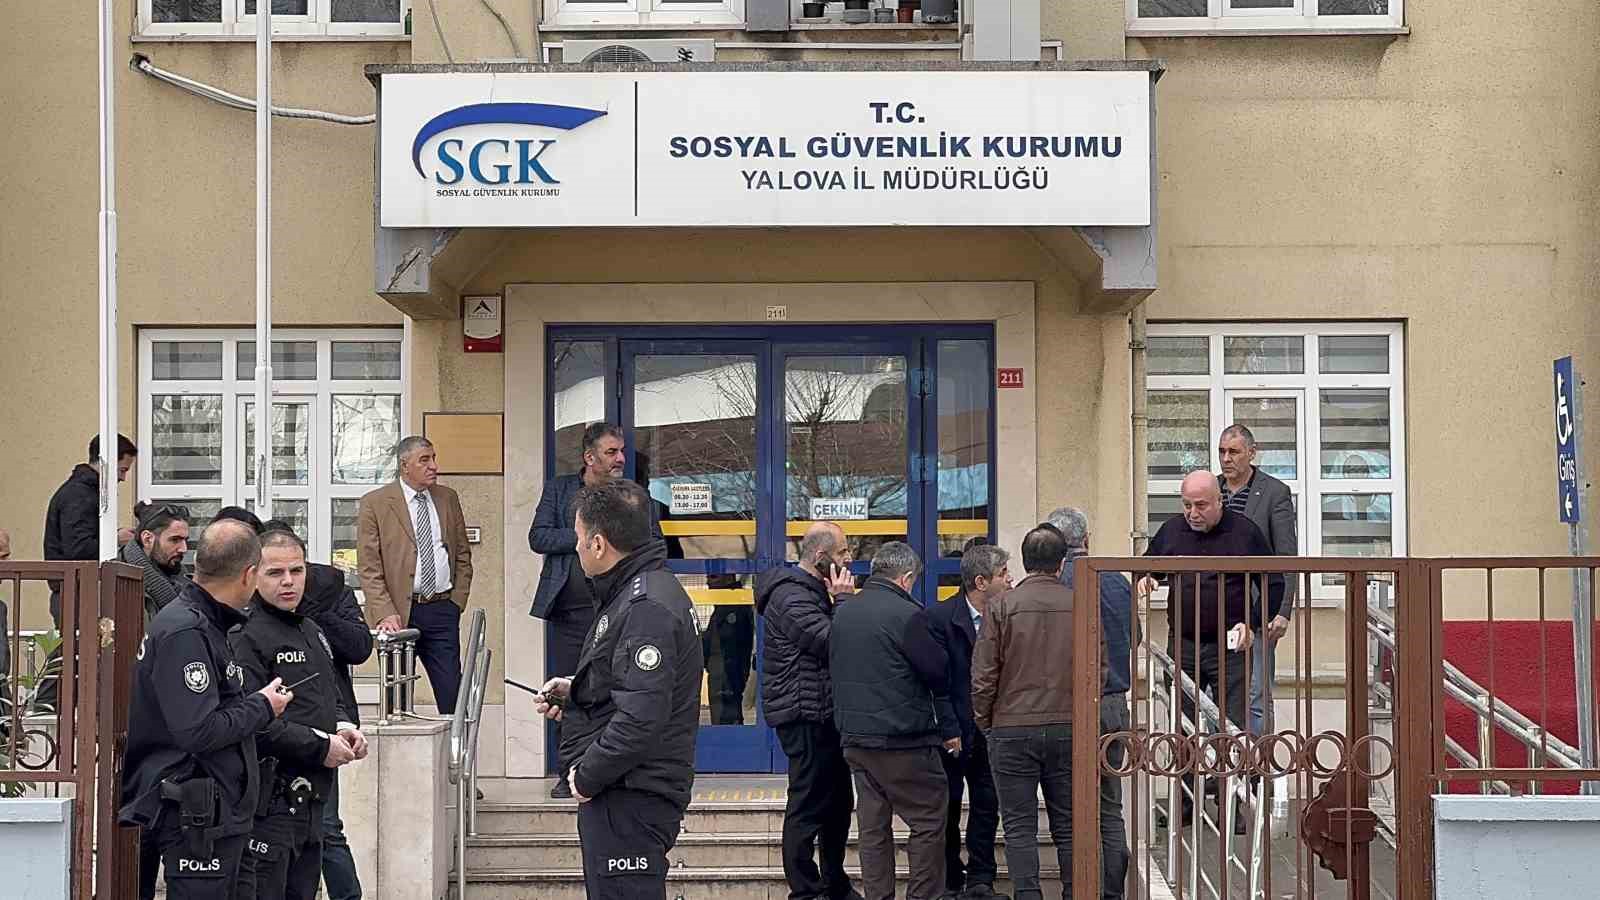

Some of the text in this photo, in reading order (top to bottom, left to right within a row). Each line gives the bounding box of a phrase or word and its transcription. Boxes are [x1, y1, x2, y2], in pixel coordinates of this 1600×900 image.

[869, 102, 926, 124] T.C.
[669, 131, 1122, 158] SOSYAL GÜVENLİK KURUMU
[435, 138, 561, 185] SGK
[741, 166, 1048, 190] YALOVA İL MÜDÜRLÜĞÜ
[436, 187, 560, 197] SOSYAL GÜVENLİK KURUMU
[1000, 372, 1021, 384] 211
[814, 502, 866, 519] ÇEKİNİZ
[608, 857, 648, 871] POLİS
